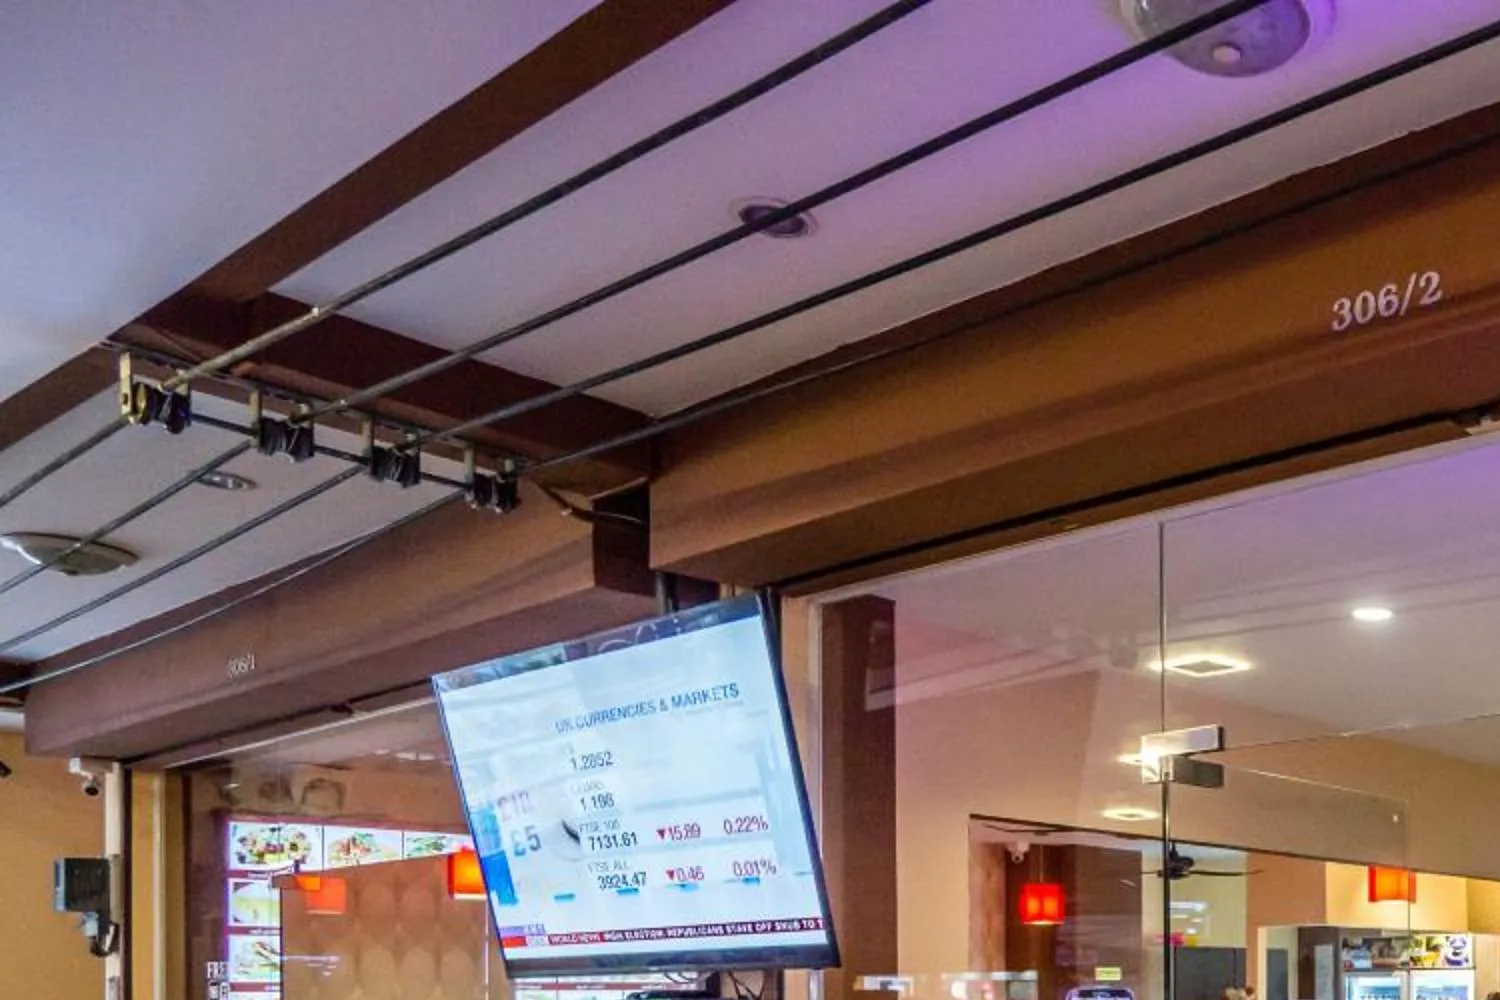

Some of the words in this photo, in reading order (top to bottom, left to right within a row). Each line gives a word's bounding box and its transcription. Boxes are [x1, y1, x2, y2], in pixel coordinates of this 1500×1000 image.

[1331, 270, 1443, 332] 306/2
[575, 698, 657, 730] CURRENCIES
[670, 682, 740, 711] MARKETS
[588, 831, 639, 851] 7131.61
[723, 815, 769, 834] 0.22%
[597, 871, 647, 891] 3924.47
